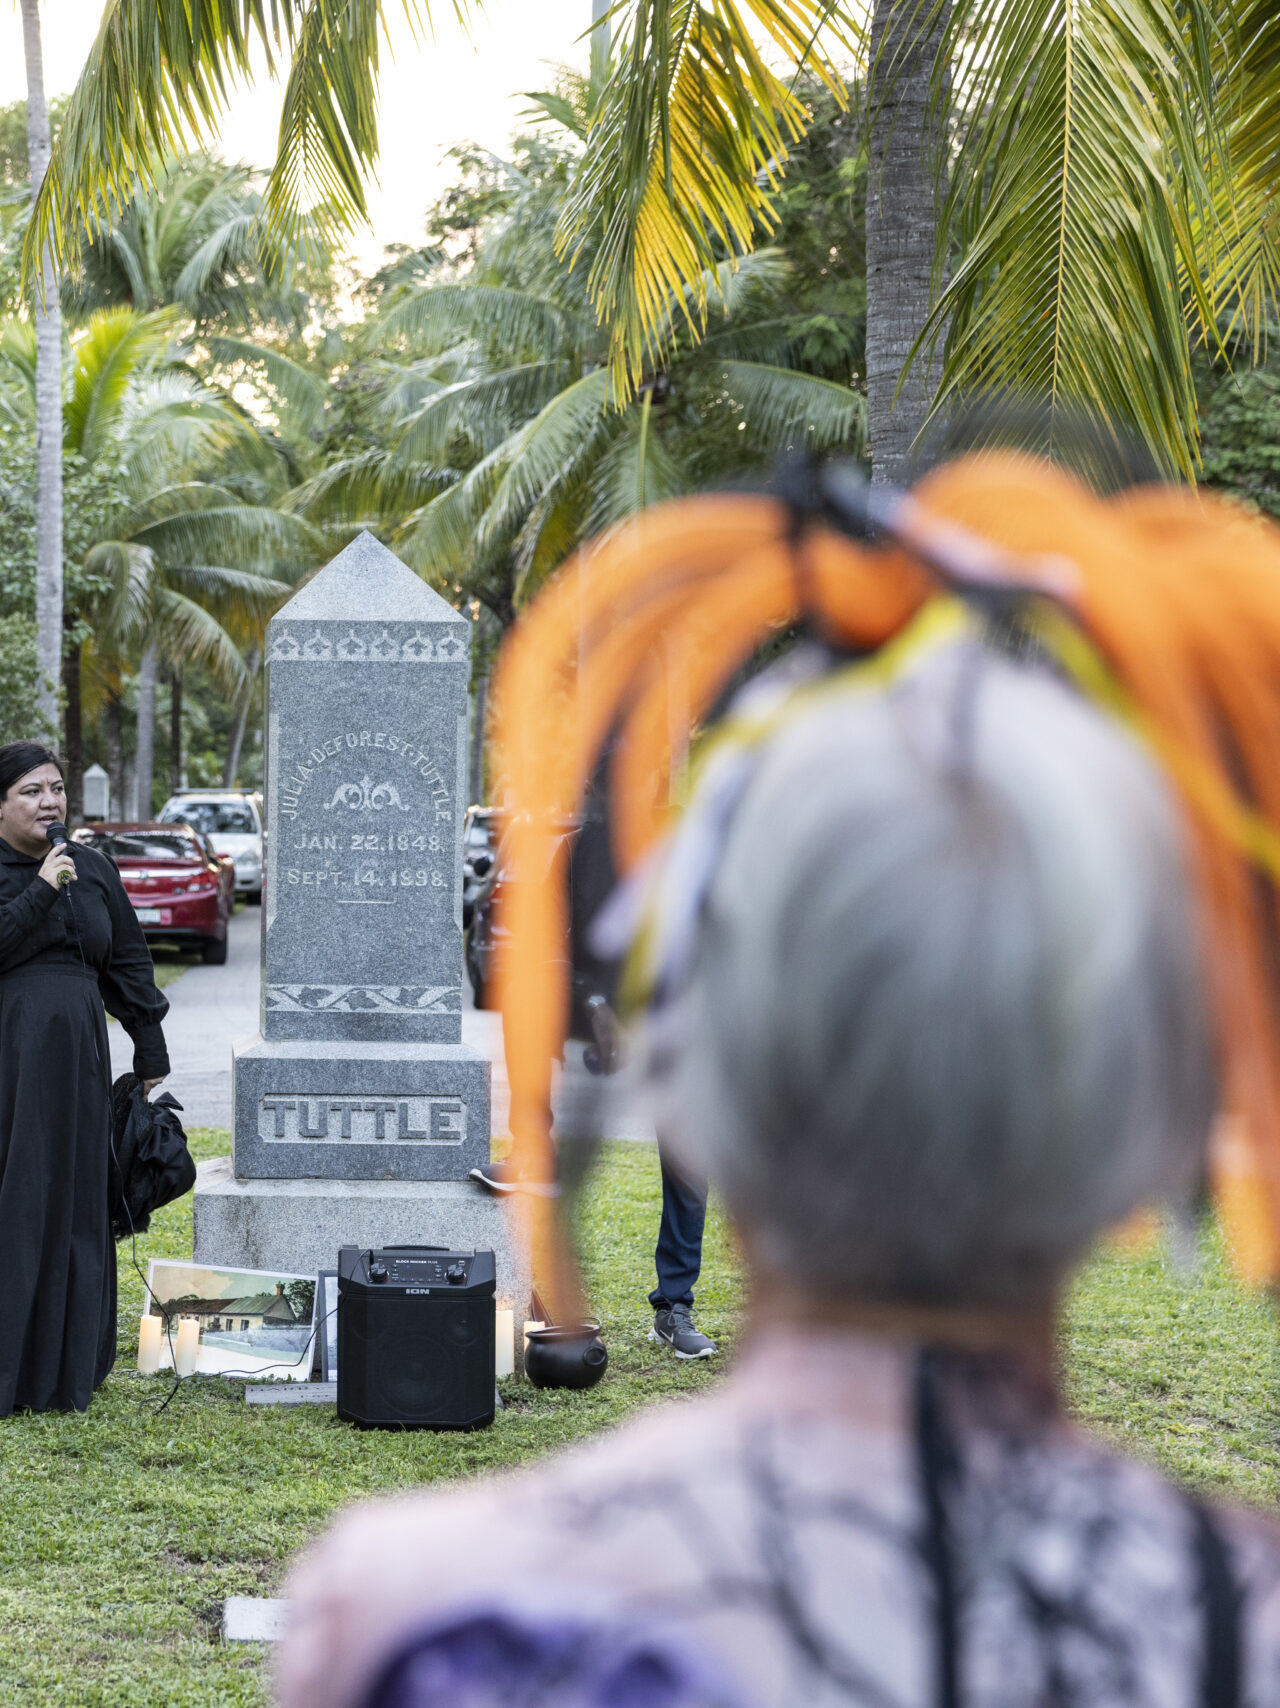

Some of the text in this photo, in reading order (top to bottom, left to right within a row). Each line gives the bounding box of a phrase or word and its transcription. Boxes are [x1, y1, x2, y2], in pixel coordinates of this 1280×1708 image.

[281, 764, 313, 820] JULIA
[294, 833, 343, 850] JAN.
[287, 868, 347, 886] SEPT.
[263, 1100, 461, 1140] TUTTLE
